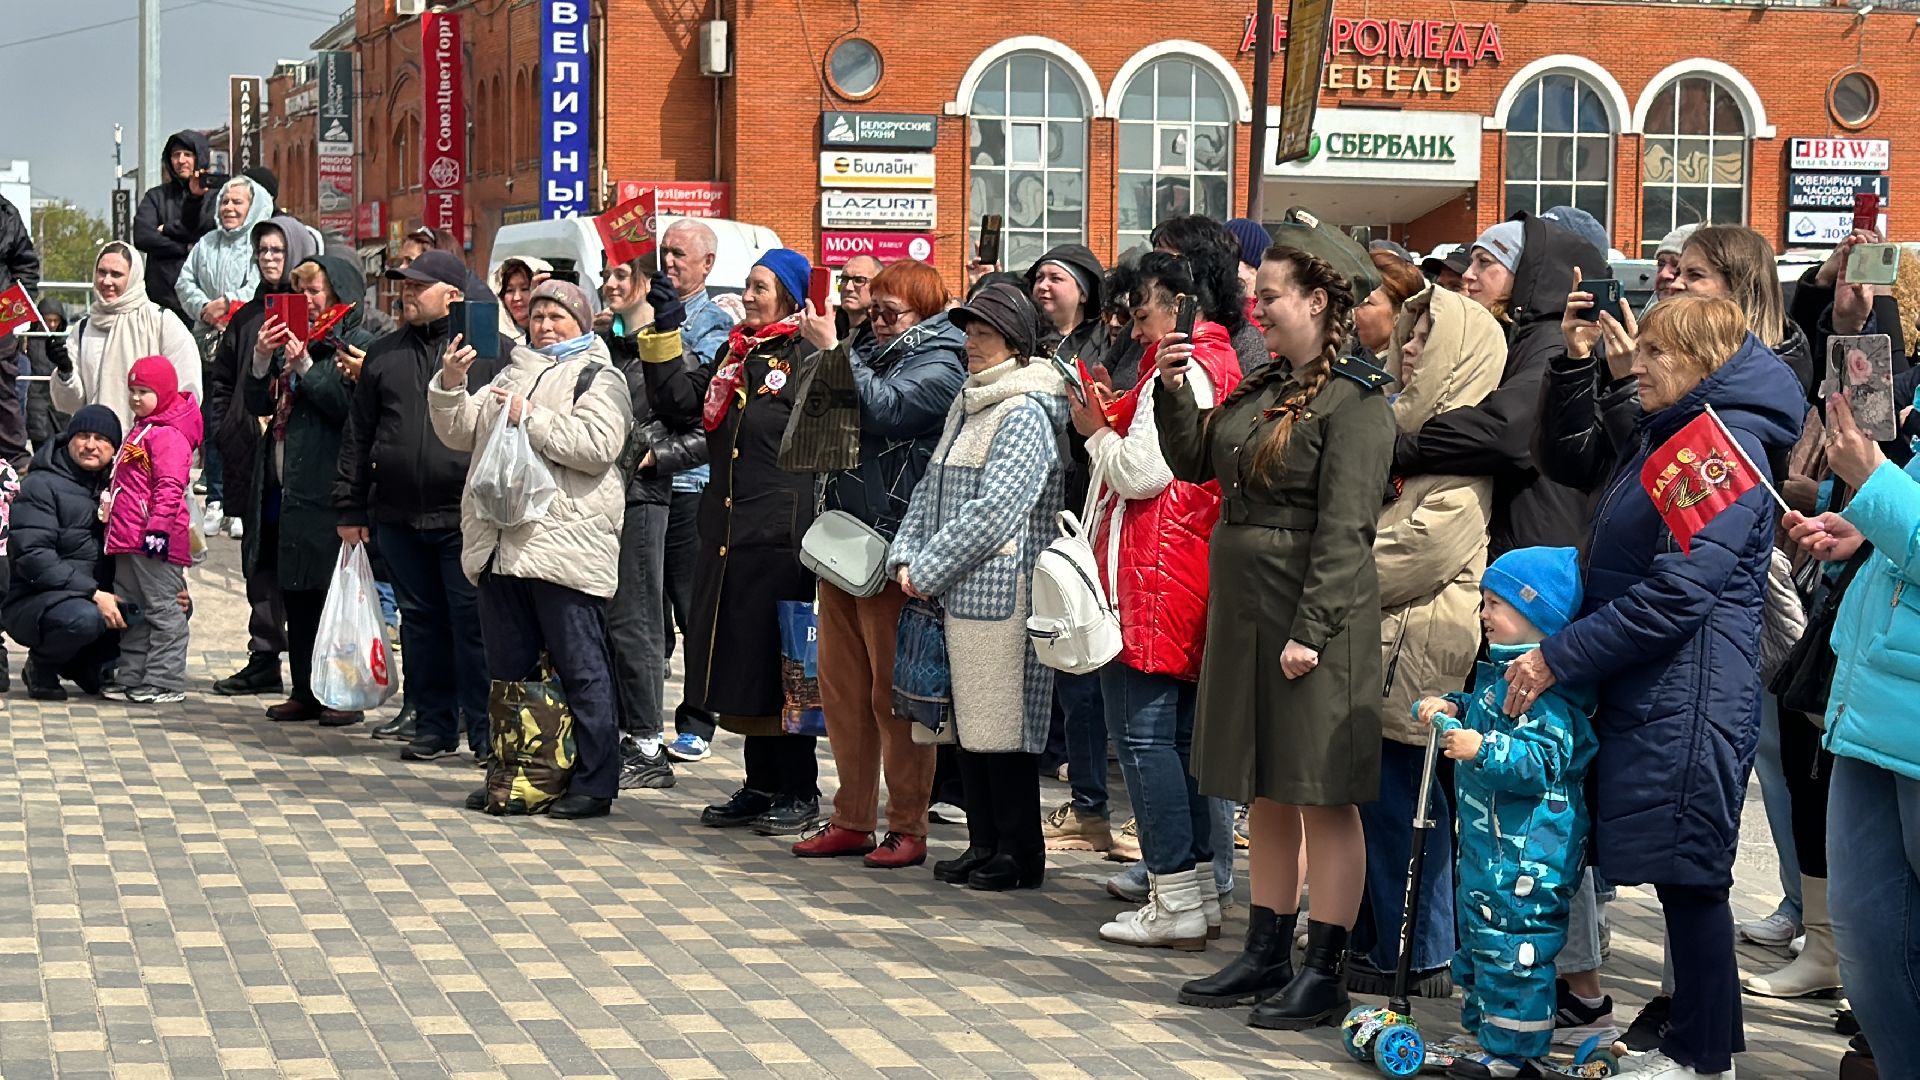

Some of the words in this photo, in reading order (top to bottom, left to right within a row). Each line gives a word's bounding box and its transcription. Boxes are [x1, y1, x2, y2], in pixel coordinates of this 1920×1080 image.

[1240, 14, 1504, 67] АНРОМЕДА
[436, 17, 453, 152] СоюзЦветТорг
[1328, 63, 1461, 93] ЕБЕЛЬ
[861, 121, 931, 131] БЕЛОРУССКИЕ
[860, 130, 896, 139] КУХНИ
[1326, 132, 1455, 158] СБЕРБАНК
[1815, 141, 1870, 158] BRW
[853, 158, 914, 174] Билайн
[1794, 175, 1862, 186] ЮВЕЛИРНАЯ
[1871, 177, 1881, 195] 1
[1802, 186, 1853, 196] ЧАСОВАЯ
[827, 197, 933, 209] LAZURIT
[1793, 194, 1856, 206] МАСТЕРСКА
[826, 237, 874, 252] MOON
